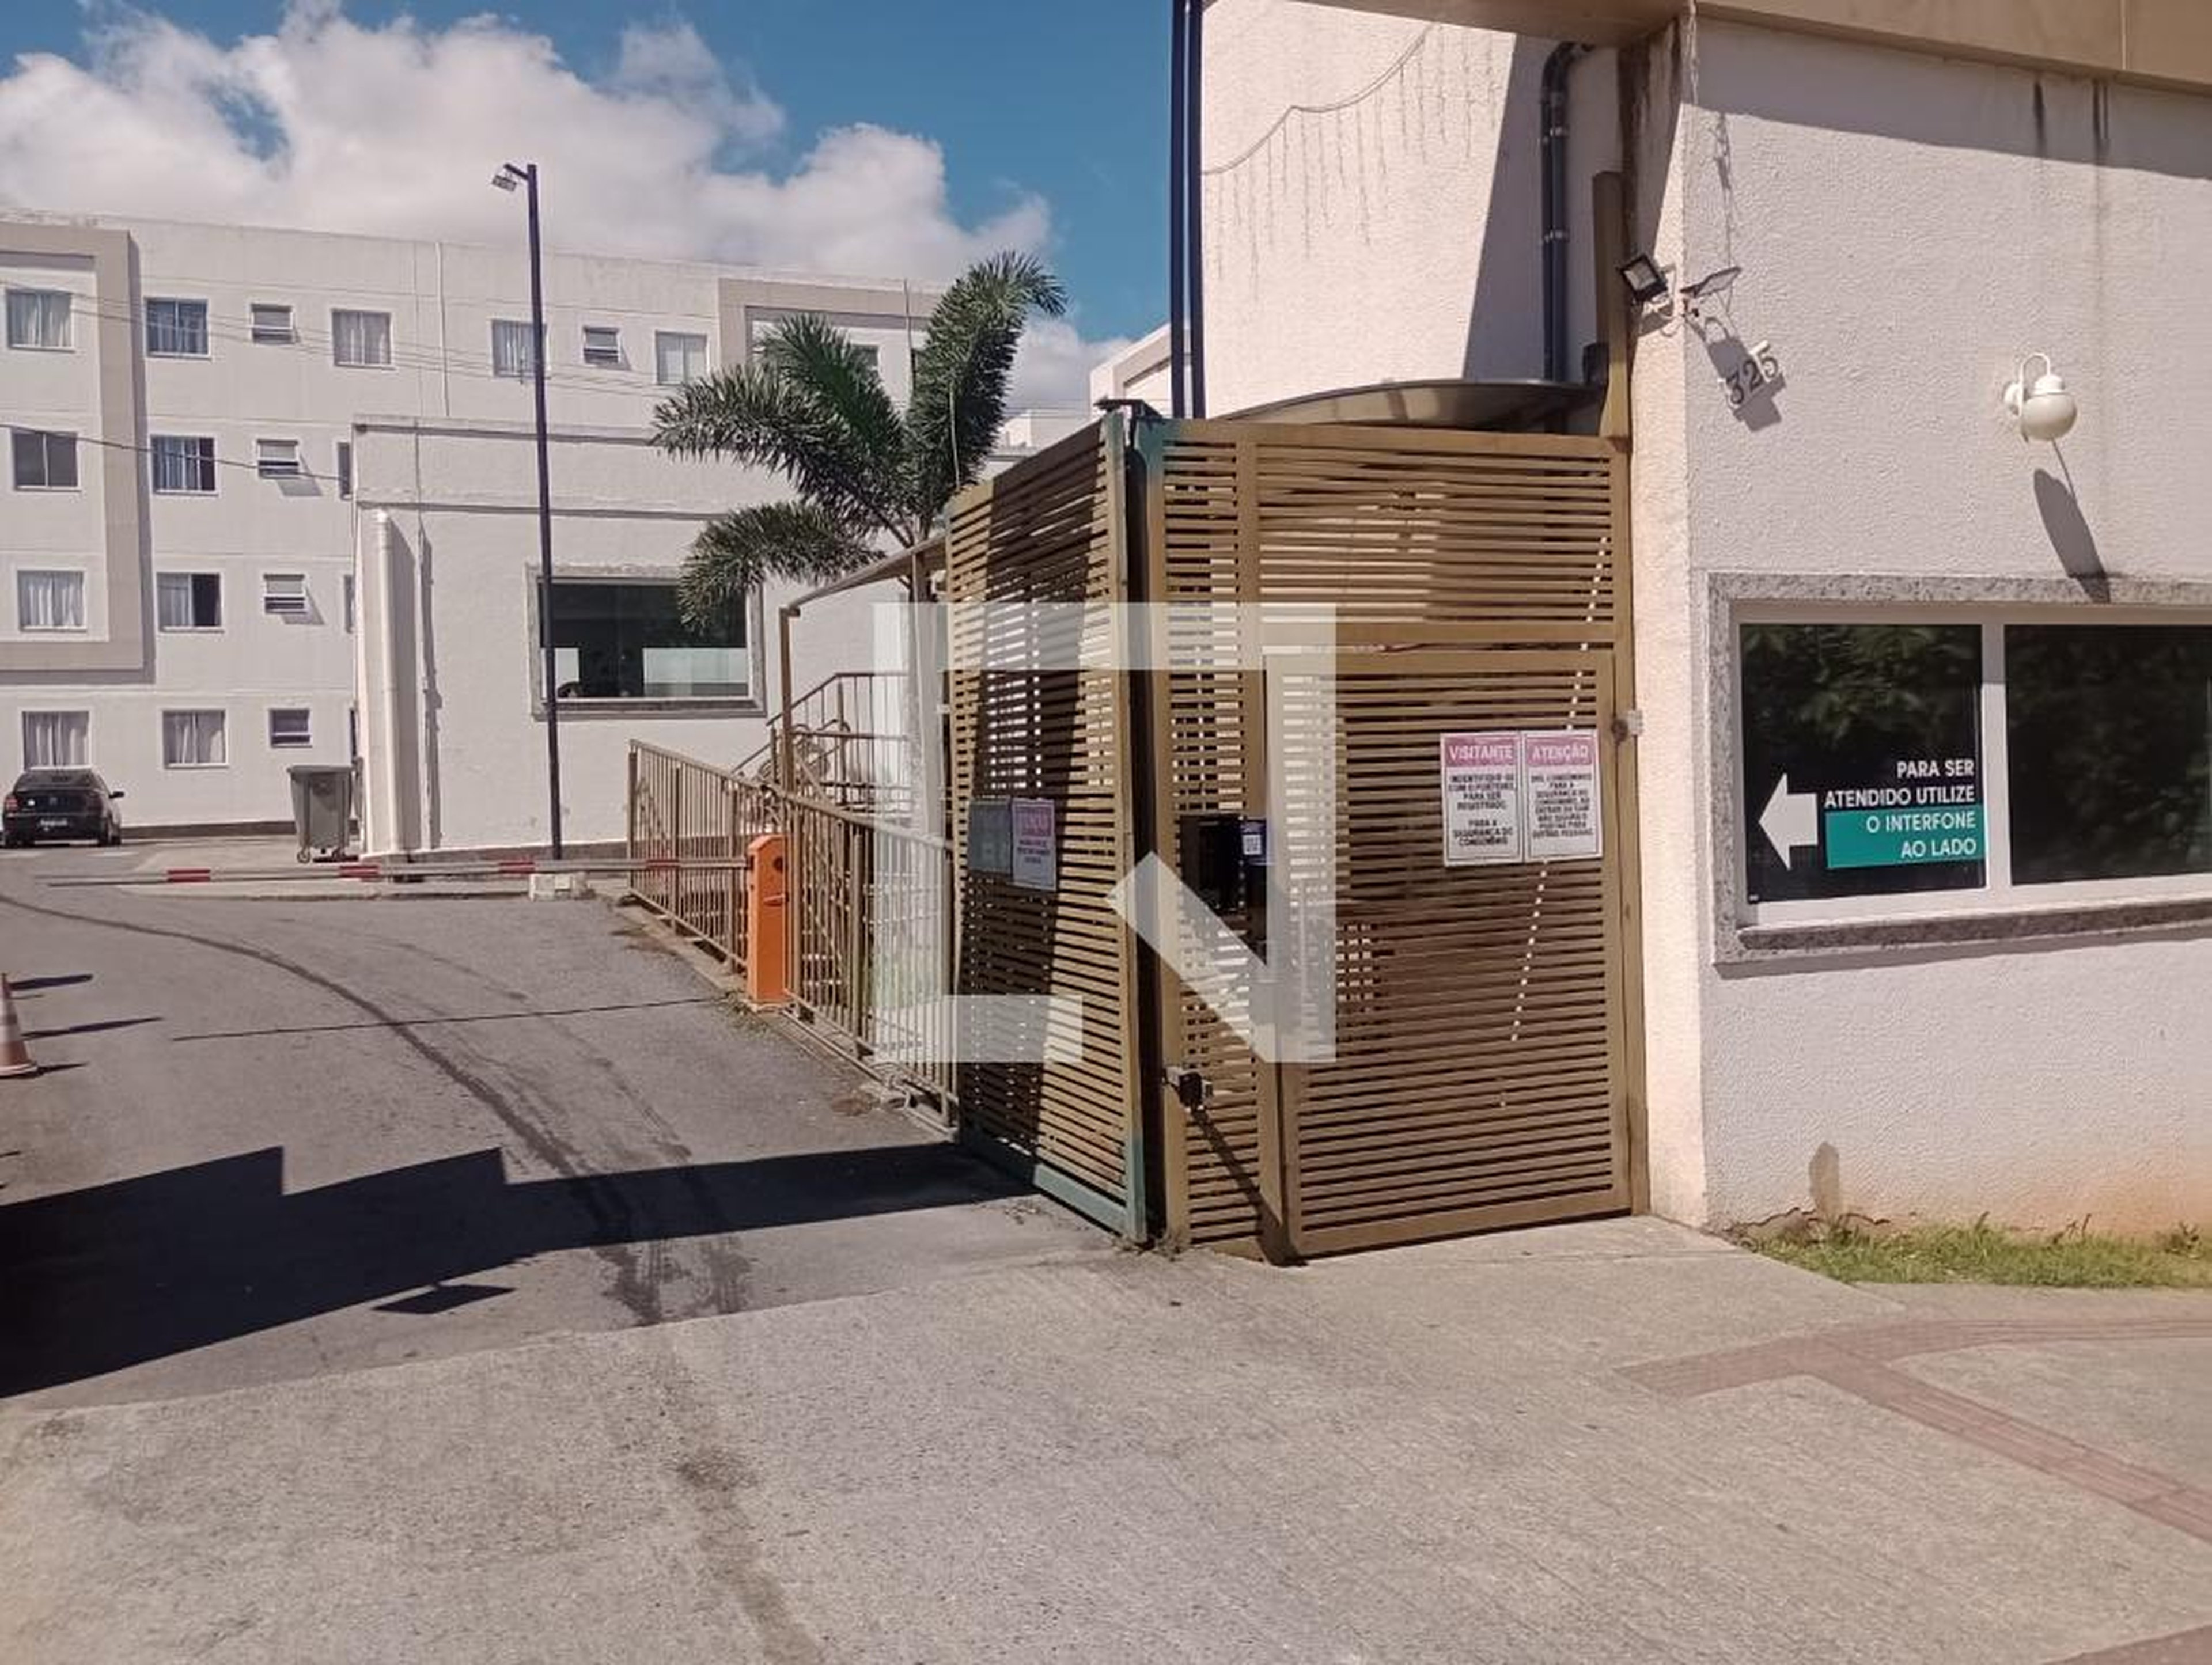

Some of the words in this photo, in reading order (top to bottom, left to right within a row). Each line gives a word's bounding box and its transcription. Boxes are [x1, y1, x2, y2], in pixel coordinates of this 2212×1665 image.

[1726, 340, 1778, 404] 325
[1449, 745, 1513, 760] VISITANTE
[1532, 742, 1588, 761] ATENÇÃO
[1897, 761, 1940, 779] PARA
[1945, 758, 1975, 777] SER
[1824, 790, 1911, 808] ATENDIDO
[1916, 786, 1975, 805] UTILIZE
[1866, 816, 1880, 833] O
[1886, 812, 1976, 832] INTERFONE
[1902, 841, 1926, 859] AO
[1931, 838, 1976, 856] LADO
